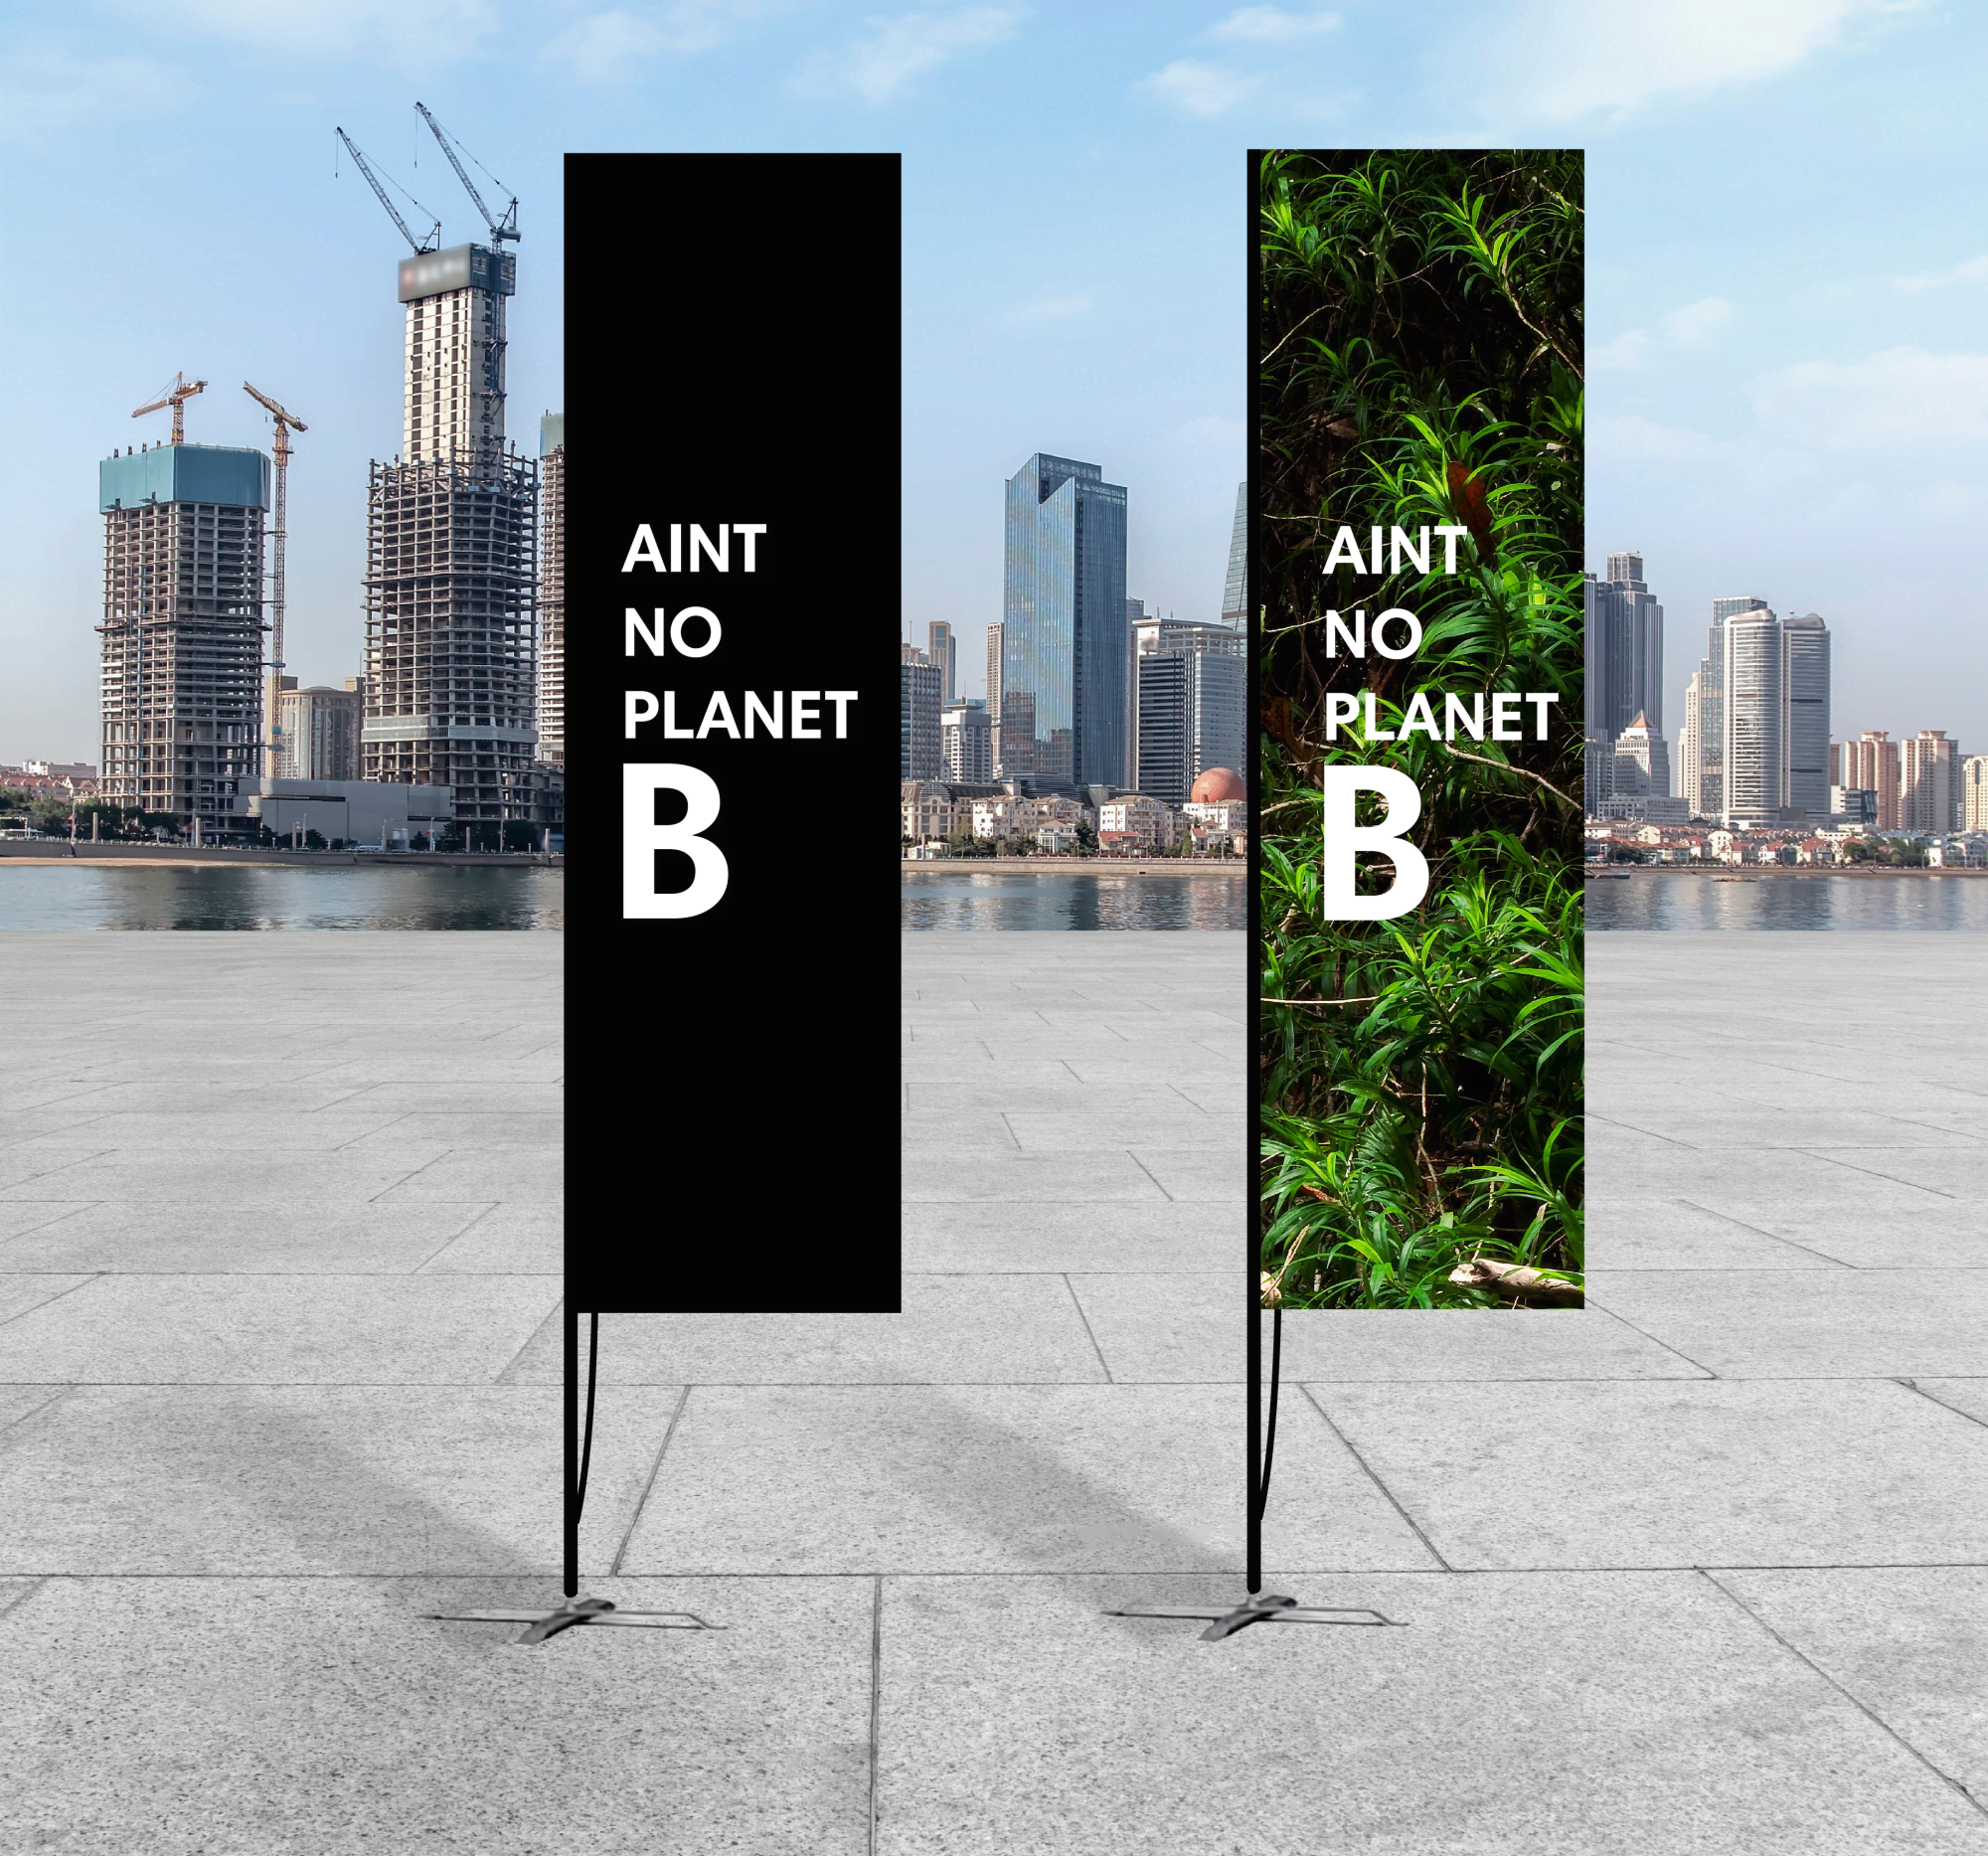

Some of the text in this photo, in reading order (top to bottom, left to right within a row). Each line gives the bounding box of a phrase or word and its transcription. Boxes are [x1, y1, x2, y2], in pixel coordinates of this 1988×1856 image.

[621, 523, 767, 574] AINT
[1323, 525, 1468, 576] AINT
[624, 606, 722, 658] NO
[1324, 608, 1422, 660] NO
[624, 690, 859, 740] PLANET
[1325, 692, 1560, 742] PLANET
[622, 762, 729, 920] B
[1323, 764, 1429, 922] B
